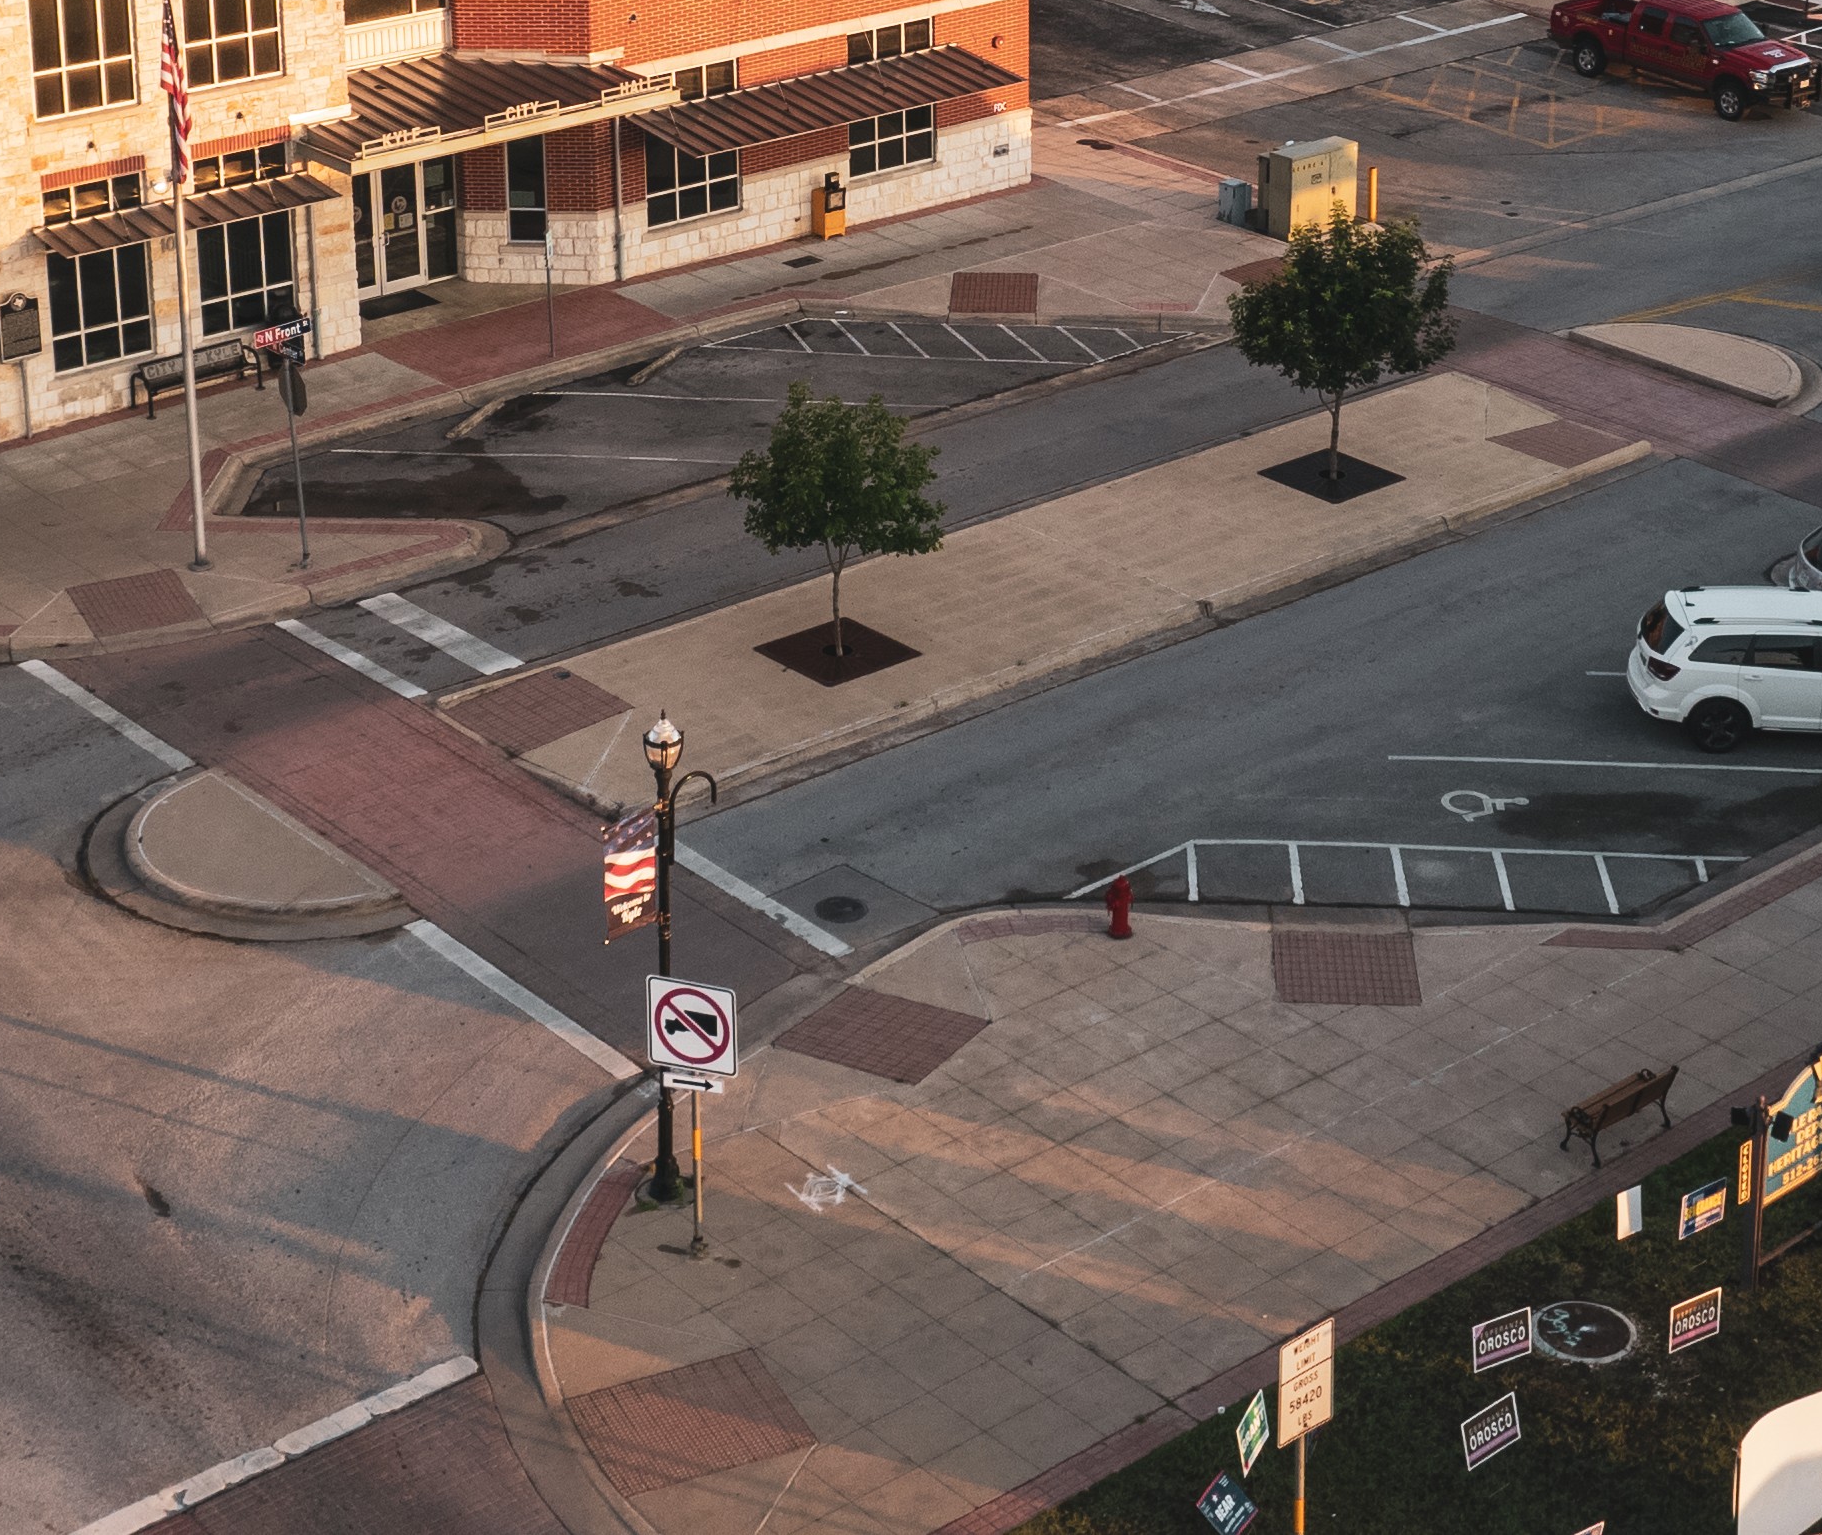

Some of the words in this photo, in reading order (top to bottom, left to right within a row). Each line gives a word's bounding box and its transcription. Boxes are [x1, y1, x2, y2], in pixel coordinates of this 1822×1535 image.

[620, 77, 654, 96] HALL
[506, 101, 539, 120] CITY
[382, 126, 421, 148] KYLE
[264, 331, 273, 342] N
[275, 322, 301, 341] Front
[146, 359, 176, 379] CITY
[206, 345, 240, 363] KYLE
[611, 896, 643, 915] Welcome
[643, 893, 651, 902] to
[621, 905, 642, 924] Kyle
[1740, 1144, 1750, 1200] CLOSED
[1480, 1320, 1524, 1339] ESPERANZA
[1674, 1306, 1716, 1335] OROSCO
[1293, 1333, 1320, 1355] WEIGHT
[1479, 1326, 1526, 1355] OROSCO
[1296, 1354, 1316, 1371] LIMIT
[1293, 1371, 1319, 1391] GROSS
[1289, 1385, 1322, 1414] 58420
[1298, 1411, 1313, 1426] LBS
[1469, 1412, 1513, 1451] OROSCO
[1215, 1494, 1236, 1522] BEAR
